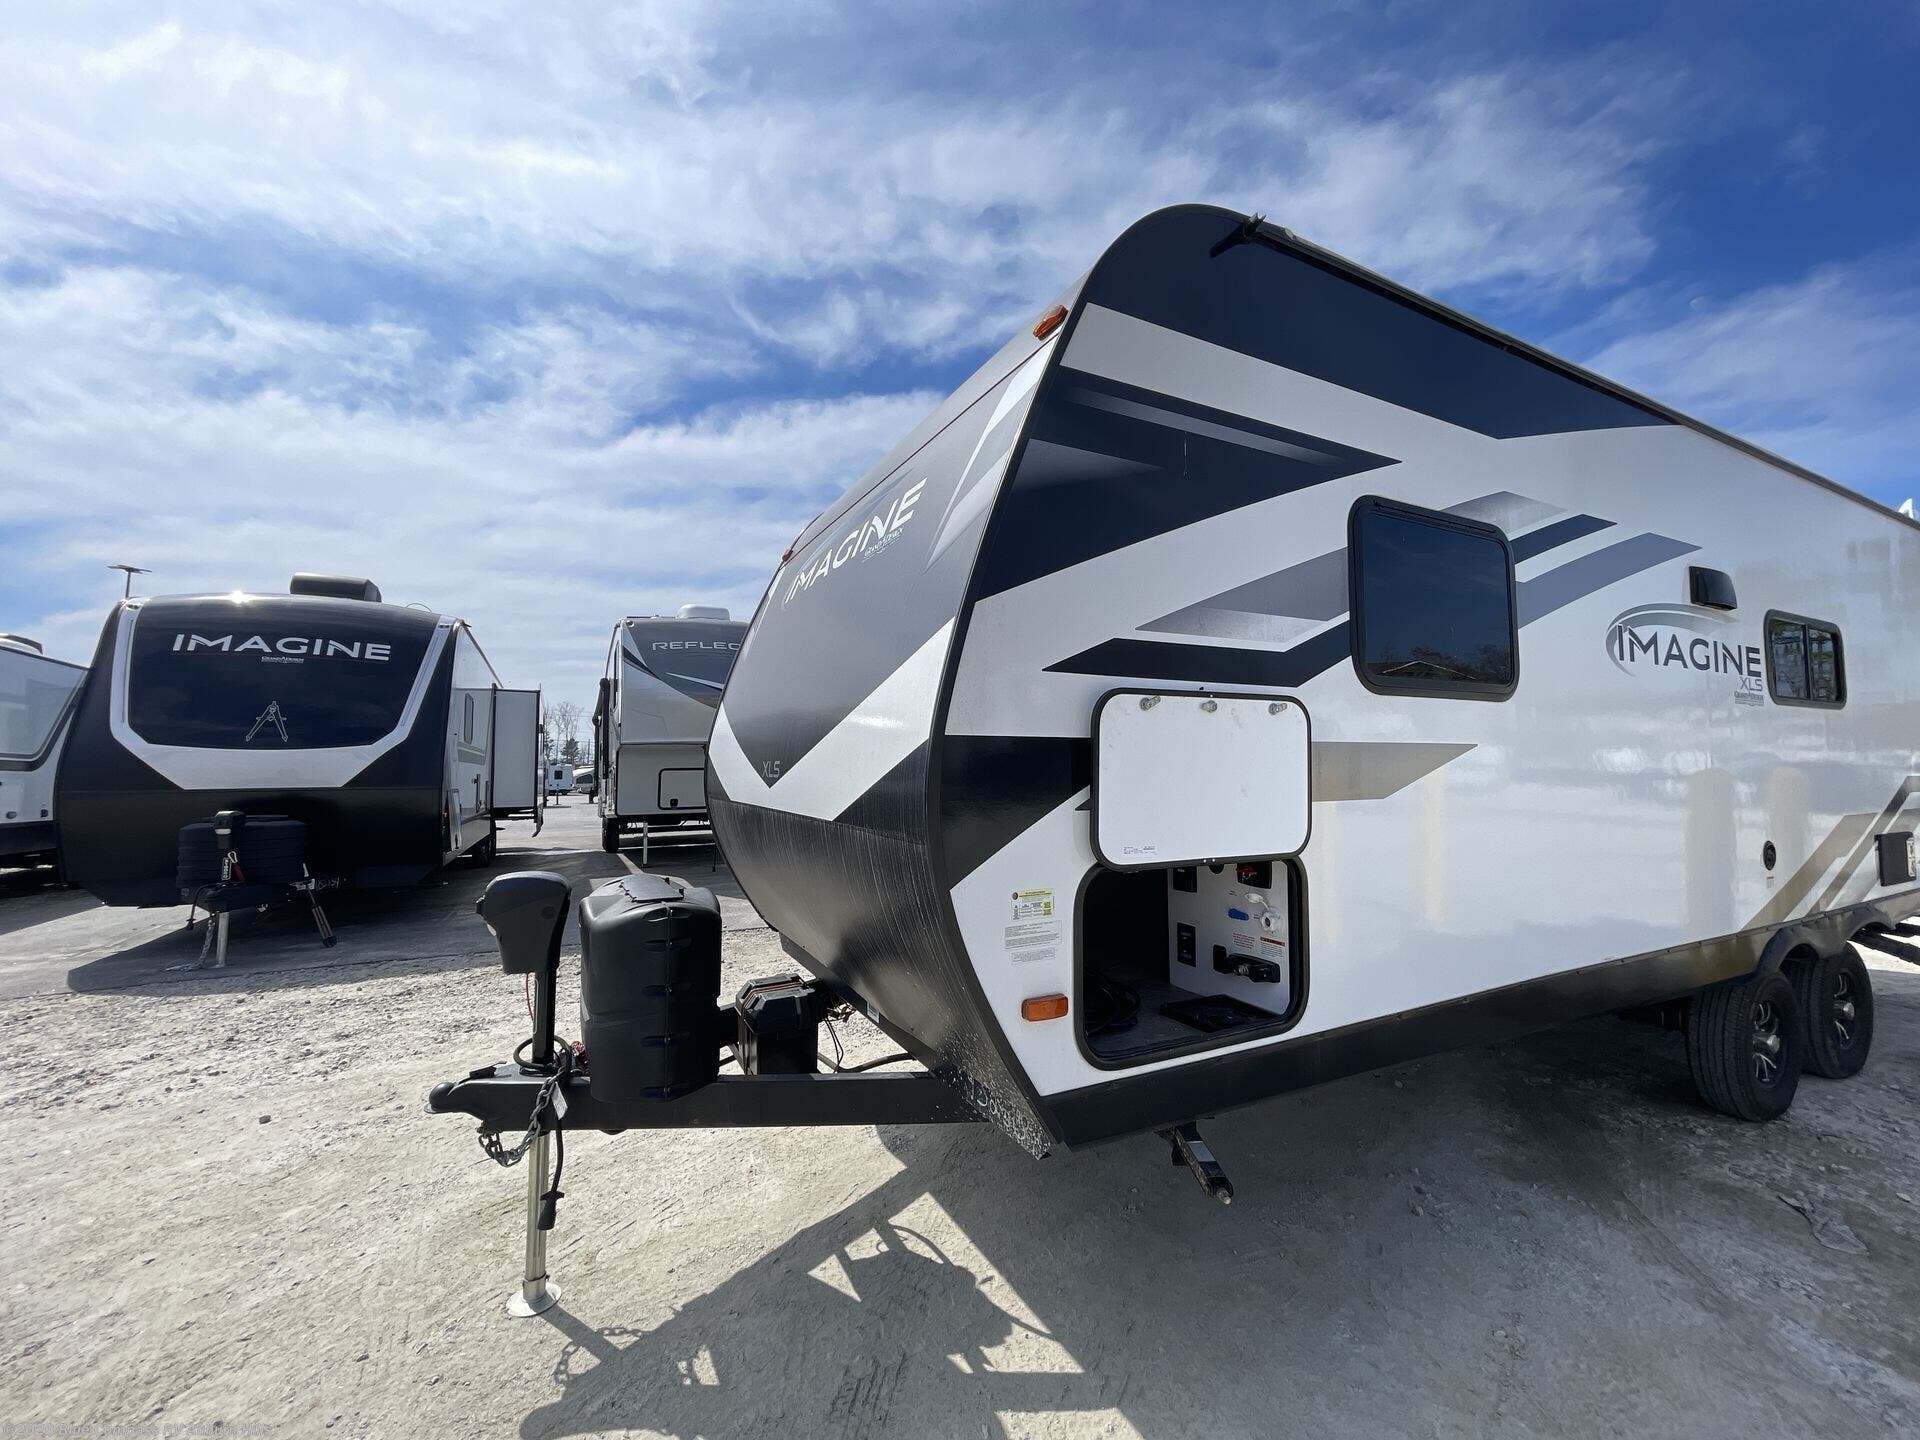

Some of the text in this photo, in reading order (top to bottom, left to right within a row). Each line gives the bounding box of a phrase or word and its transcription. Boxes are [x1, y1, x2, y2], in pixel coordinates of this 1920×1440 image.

[785, 477, 928, 604] IMAGINE
[172, 633, 392, 661] IMAGINE
[1616, 624, 1762, 678] IMAGINE
[1740, 676, 1763, 691] XLS
[761, 760, 780, 778] XLS
